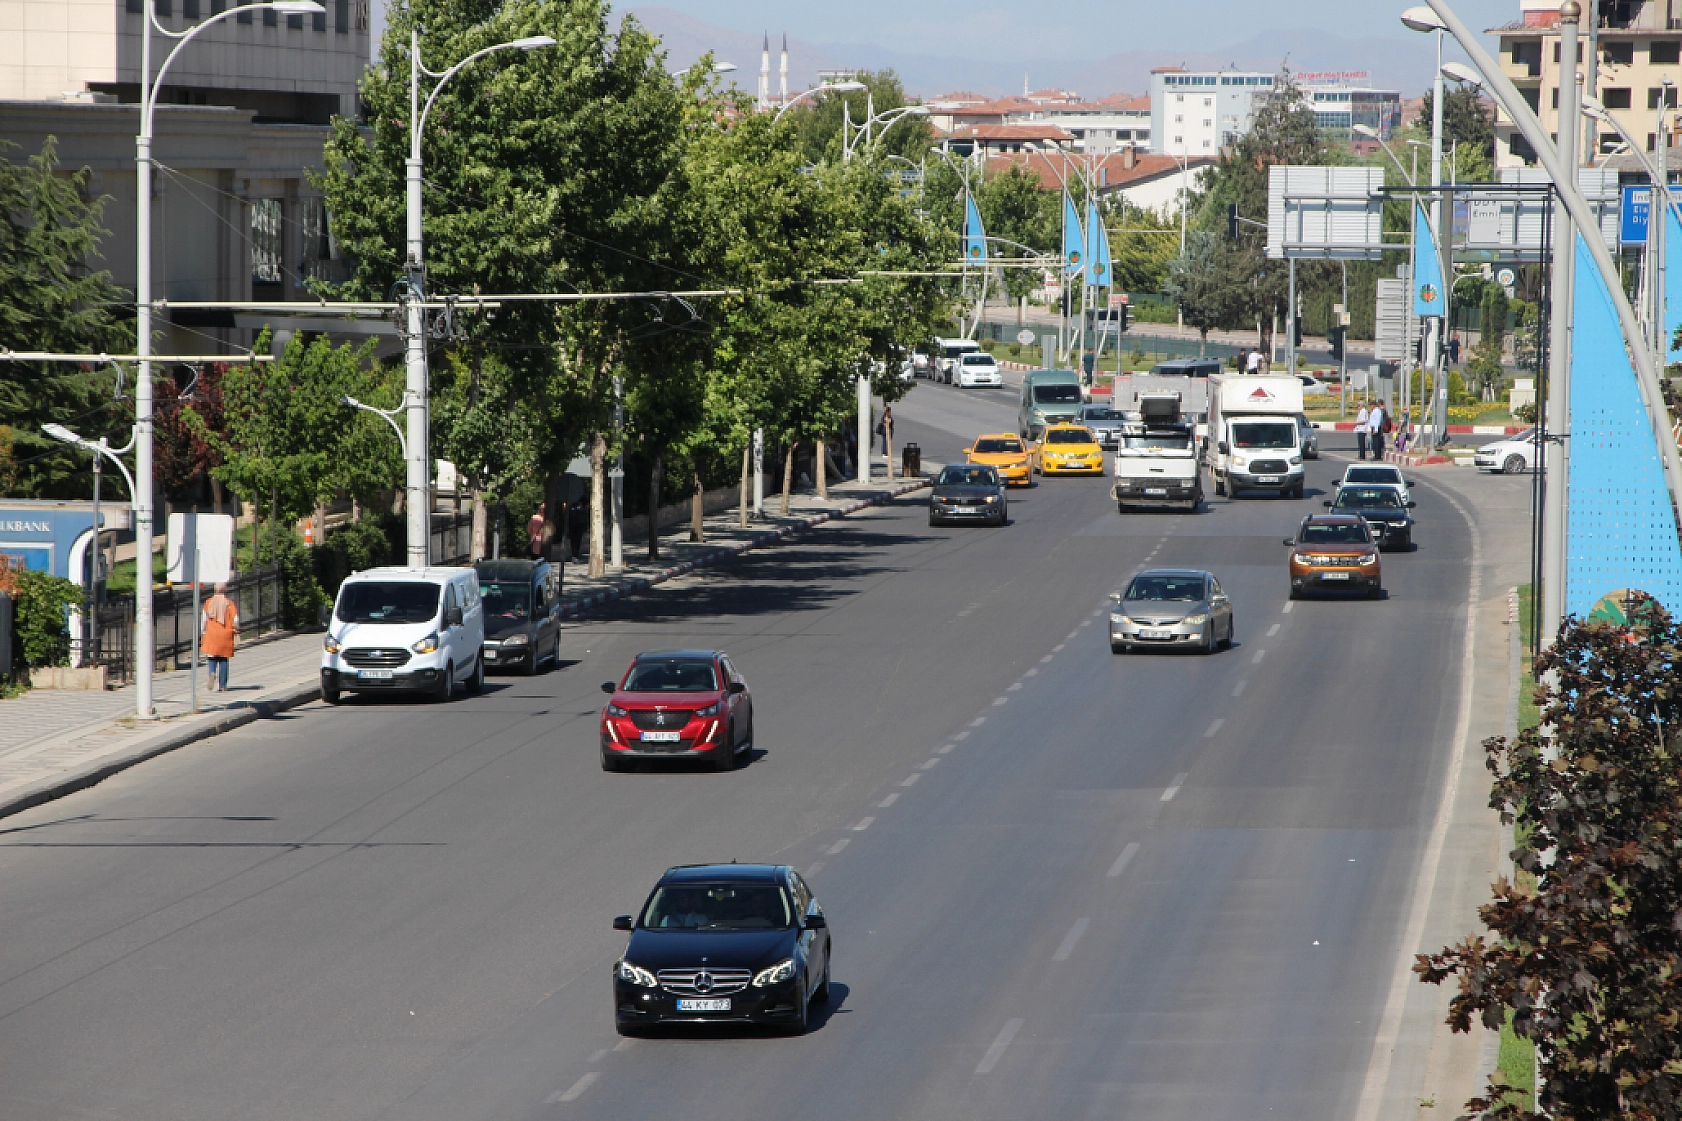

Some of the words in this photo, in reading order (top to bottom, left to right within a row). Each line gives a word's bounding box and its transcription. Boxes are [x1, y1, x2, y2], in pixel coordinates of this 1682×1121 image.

[1473, 209, 1498, 217] Emni
[1633, 205, 1648, 213] Ela
[1633, 215, 1648, 226] Diy
[696, 1001, 709, 1009] KY
